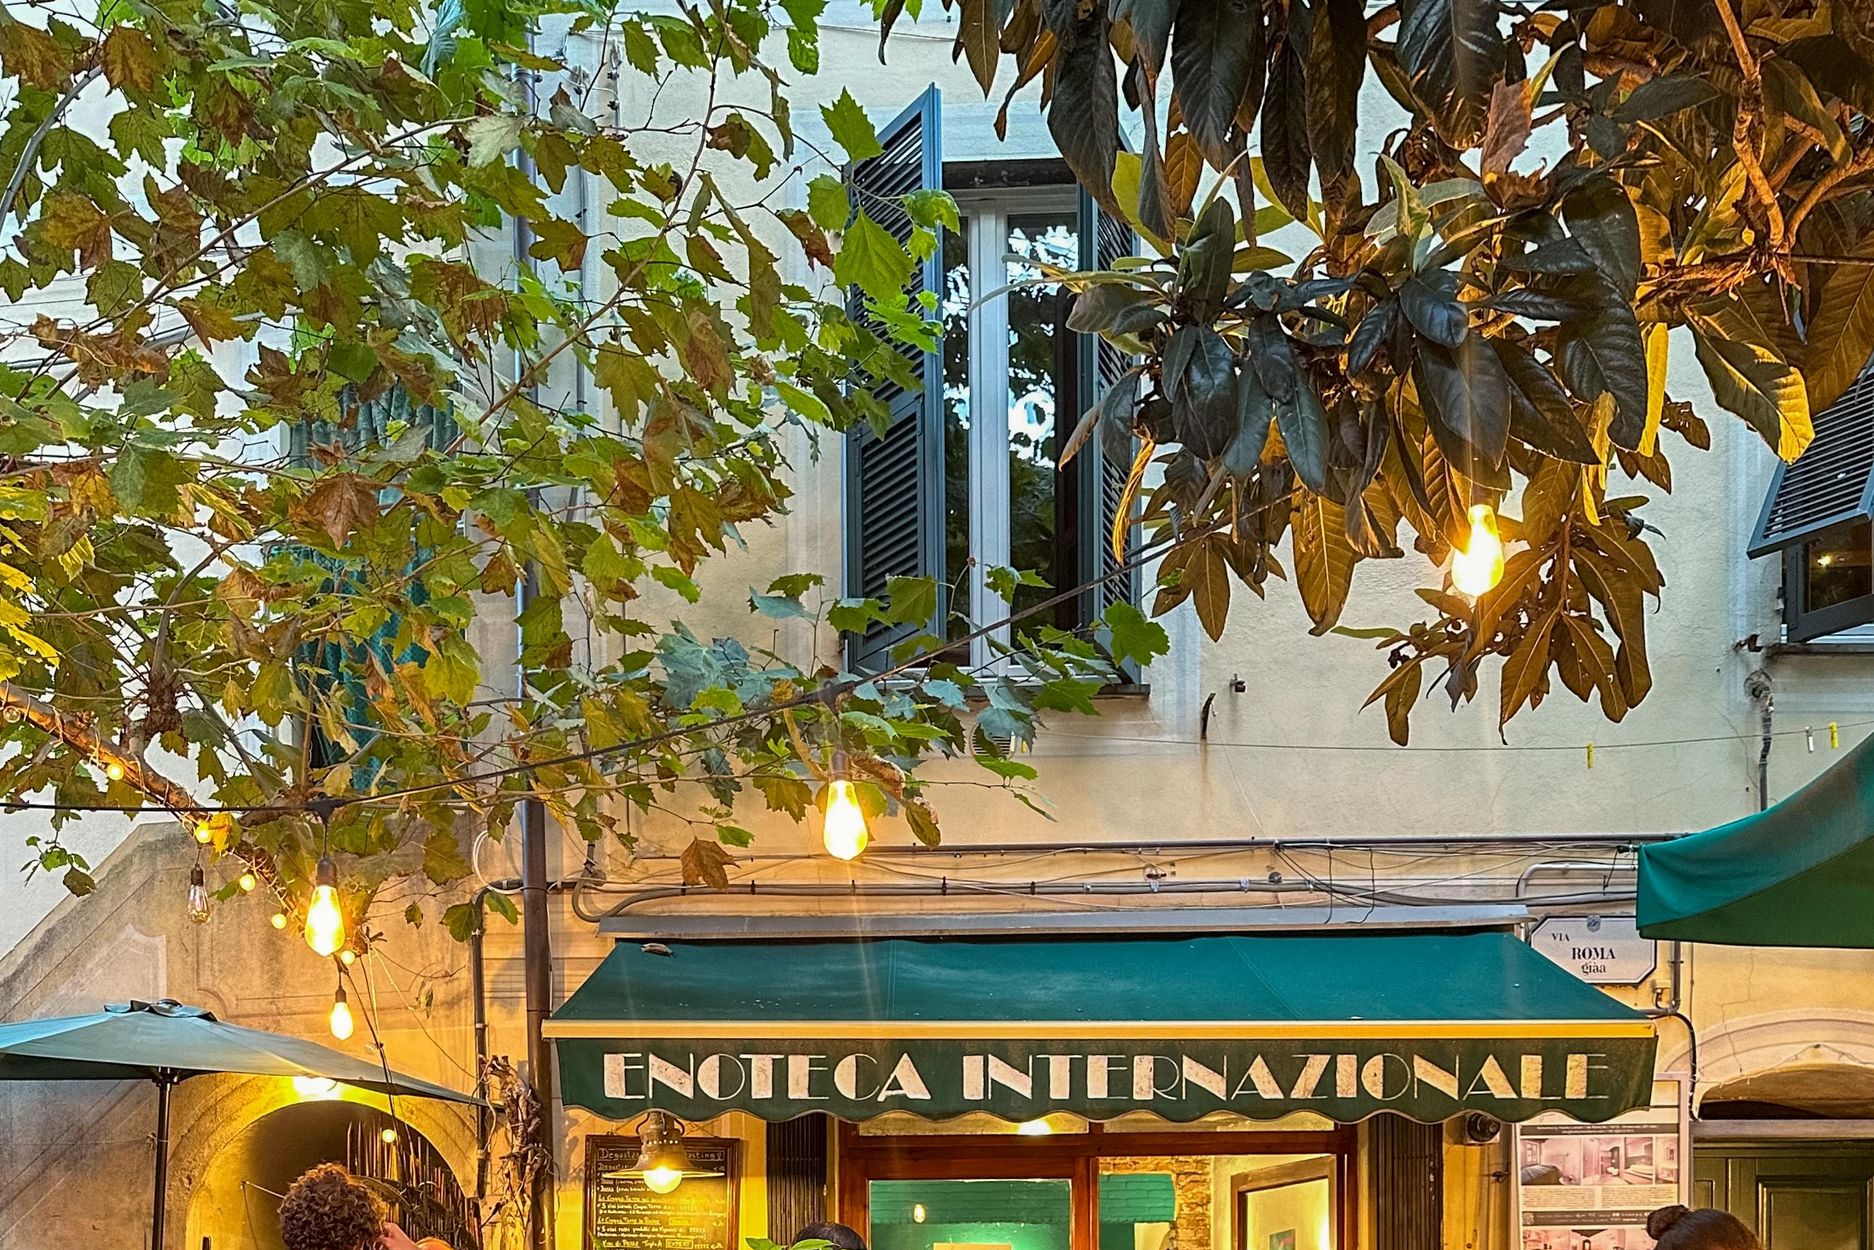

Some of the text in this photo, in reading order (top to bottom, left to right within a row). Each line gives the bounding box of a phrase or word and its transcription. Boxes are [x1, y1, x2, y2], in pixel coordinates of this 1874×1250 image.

[1551, 932, 1570, 942] VIA
[1571, 947, 1616, 960] ROMA
[1581, 962, 1606, 974] giàa
[603, 1052, 1608, 1102] ENOTECA INTERNAZIONALE
